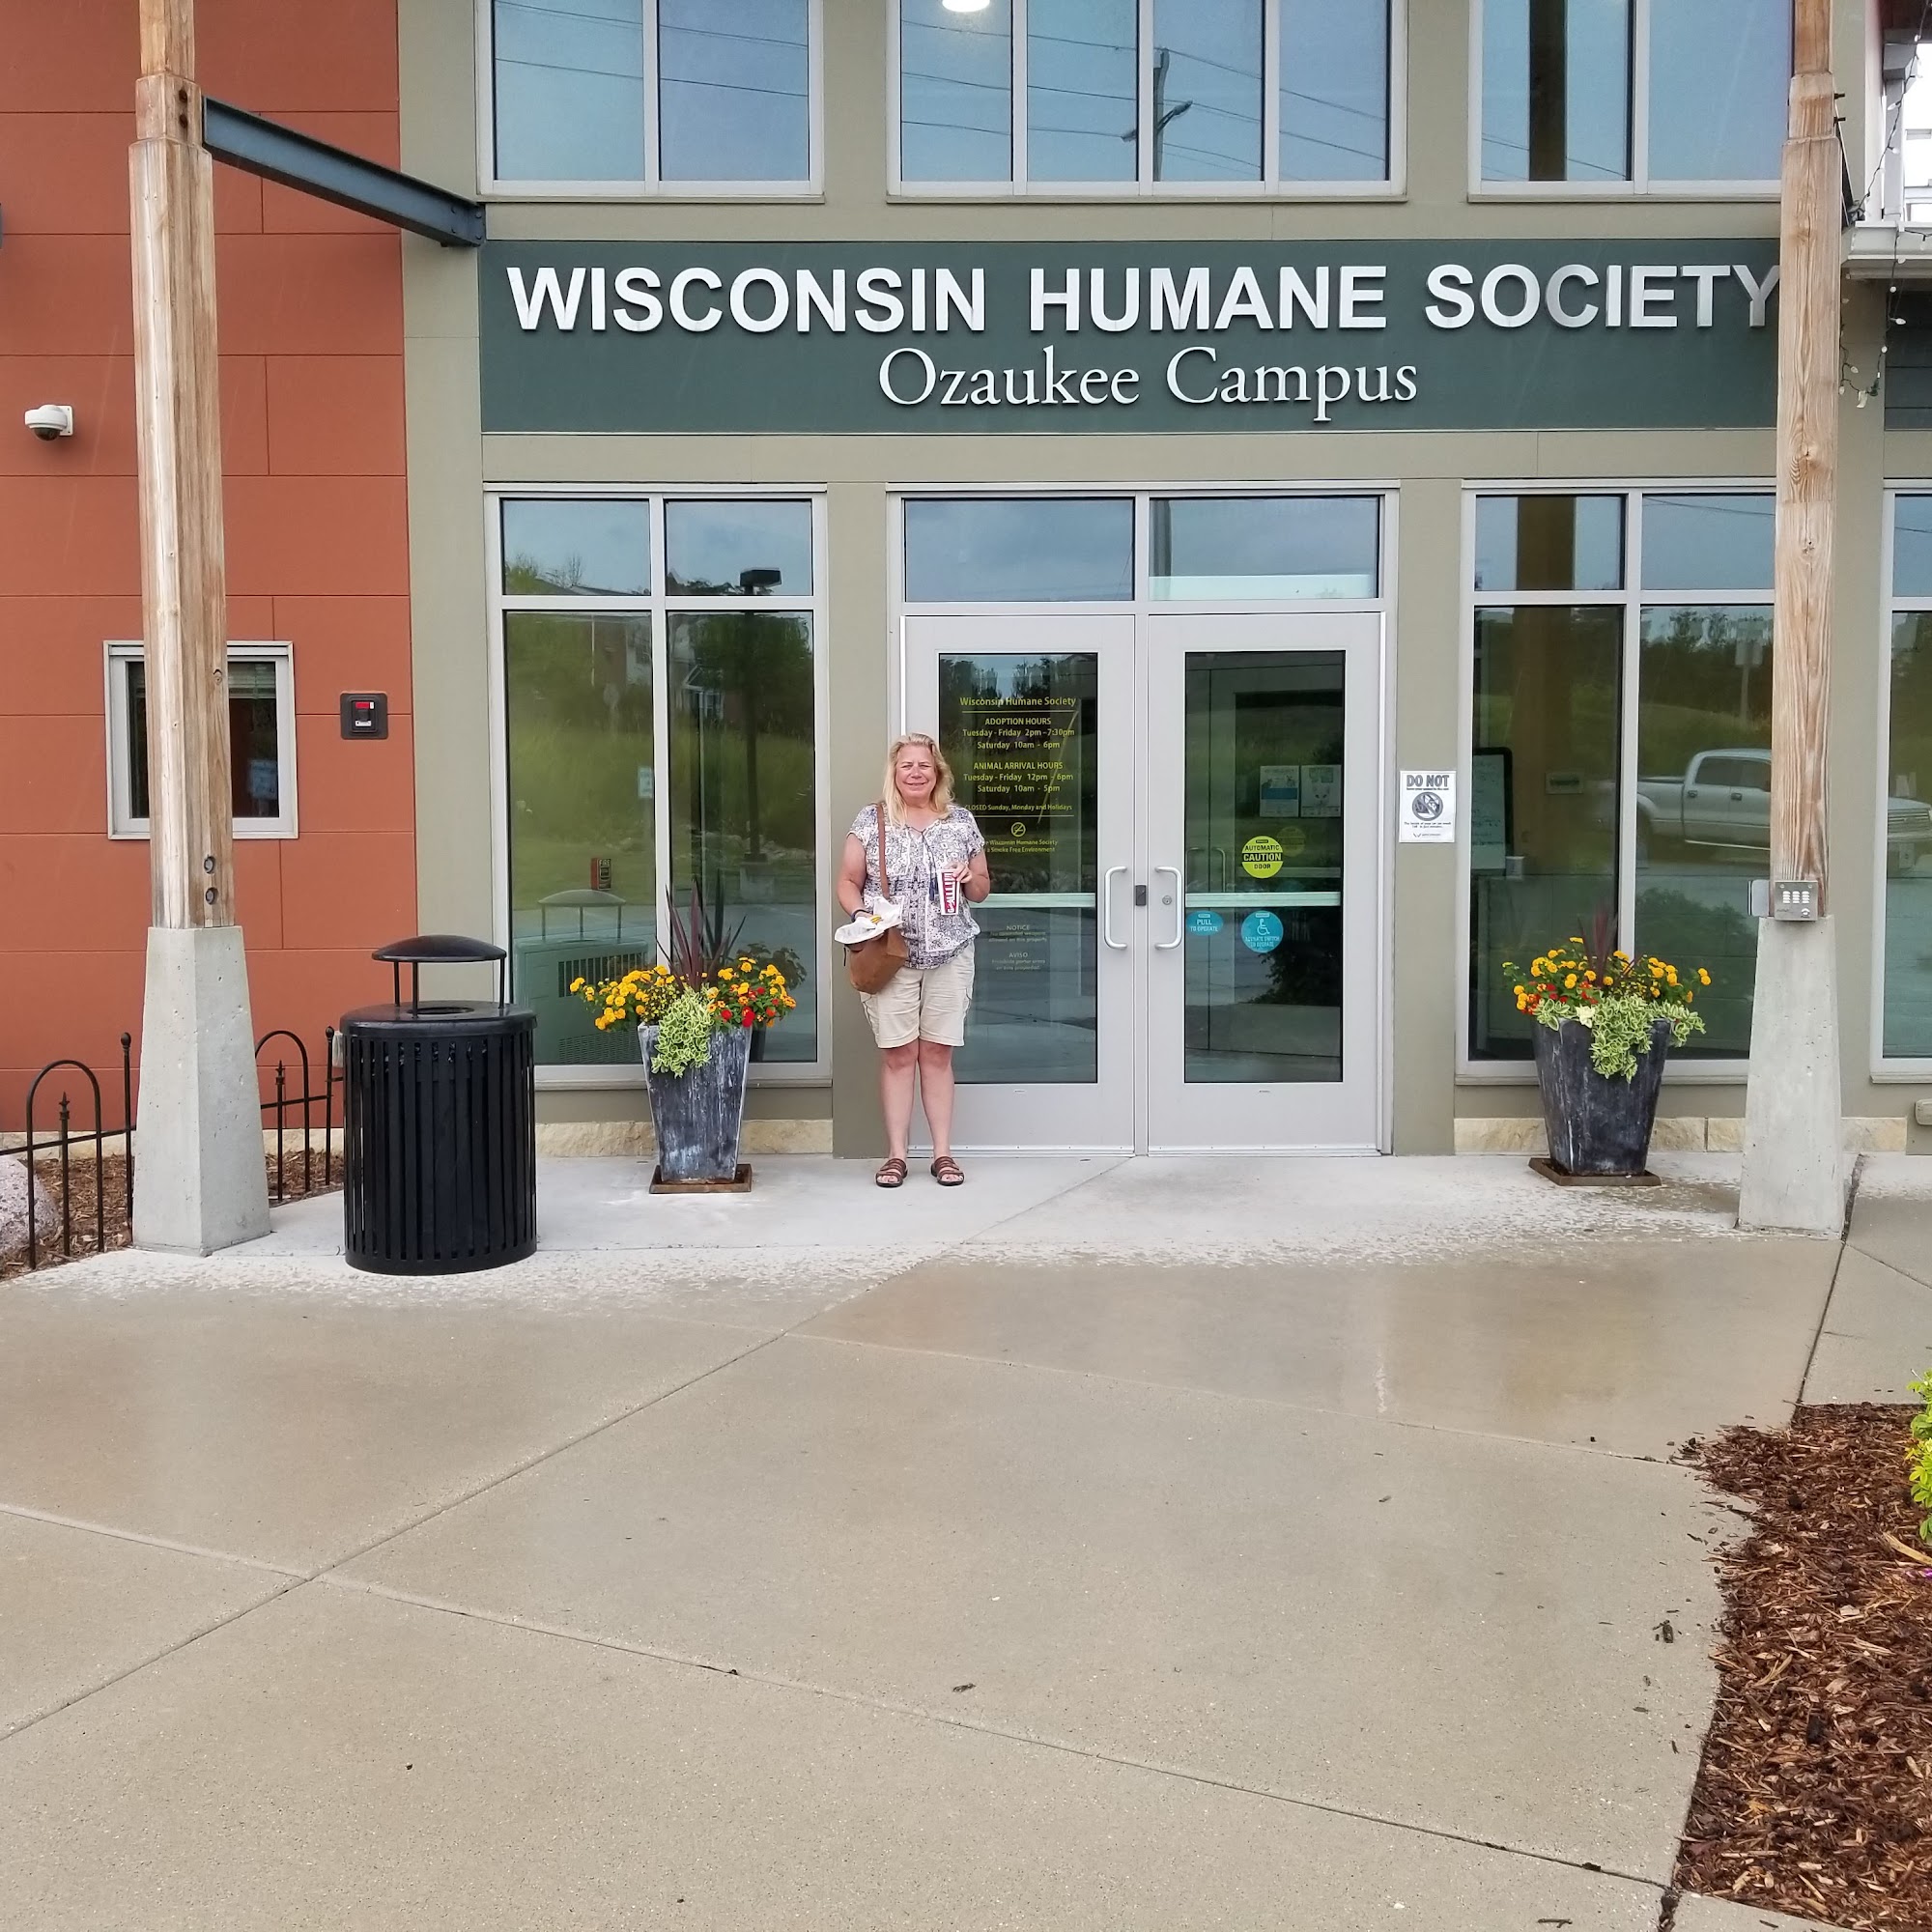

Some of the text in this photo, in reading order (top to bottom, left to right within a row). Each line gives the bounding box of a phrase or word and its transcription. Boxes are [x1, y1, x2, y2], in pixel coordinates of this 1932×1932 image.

[506, 263, 1780, 332] WISCONSIN HUMANE SOCIETY
[878, 345, 1417, 422] Ozaukee Campus
[959, 696, 1077, 707] Wisconsin Humane Society
[962, 728, 993, 738] Tuesday
[998, 728, 1022, 738] Friday
[1025, 728, 1042, 738] 2pm
[977, 741, 1010, 751] Saturday
[1043, 741, 1061, 751] 6pm
[1005, 761, 1037, 770] ARRIVAL
[1037, 761, 1064, 770] HOURS
[963, 774, 994, 782] Tuesday
[999, 774, 1023, 782] Friday
[1027, 774, 1048, 782] 12pm
[1057, 774, 1074, 782] 6pm
[1406, 775, 1450, 787] DO NOT
[977, 784, 1010, 794] Saturday
[1043, 784, 1061, 794] 5pm
[1011, 804, 1035, 812] Monday
[1243, 853, 1282, 862] CAUTION
